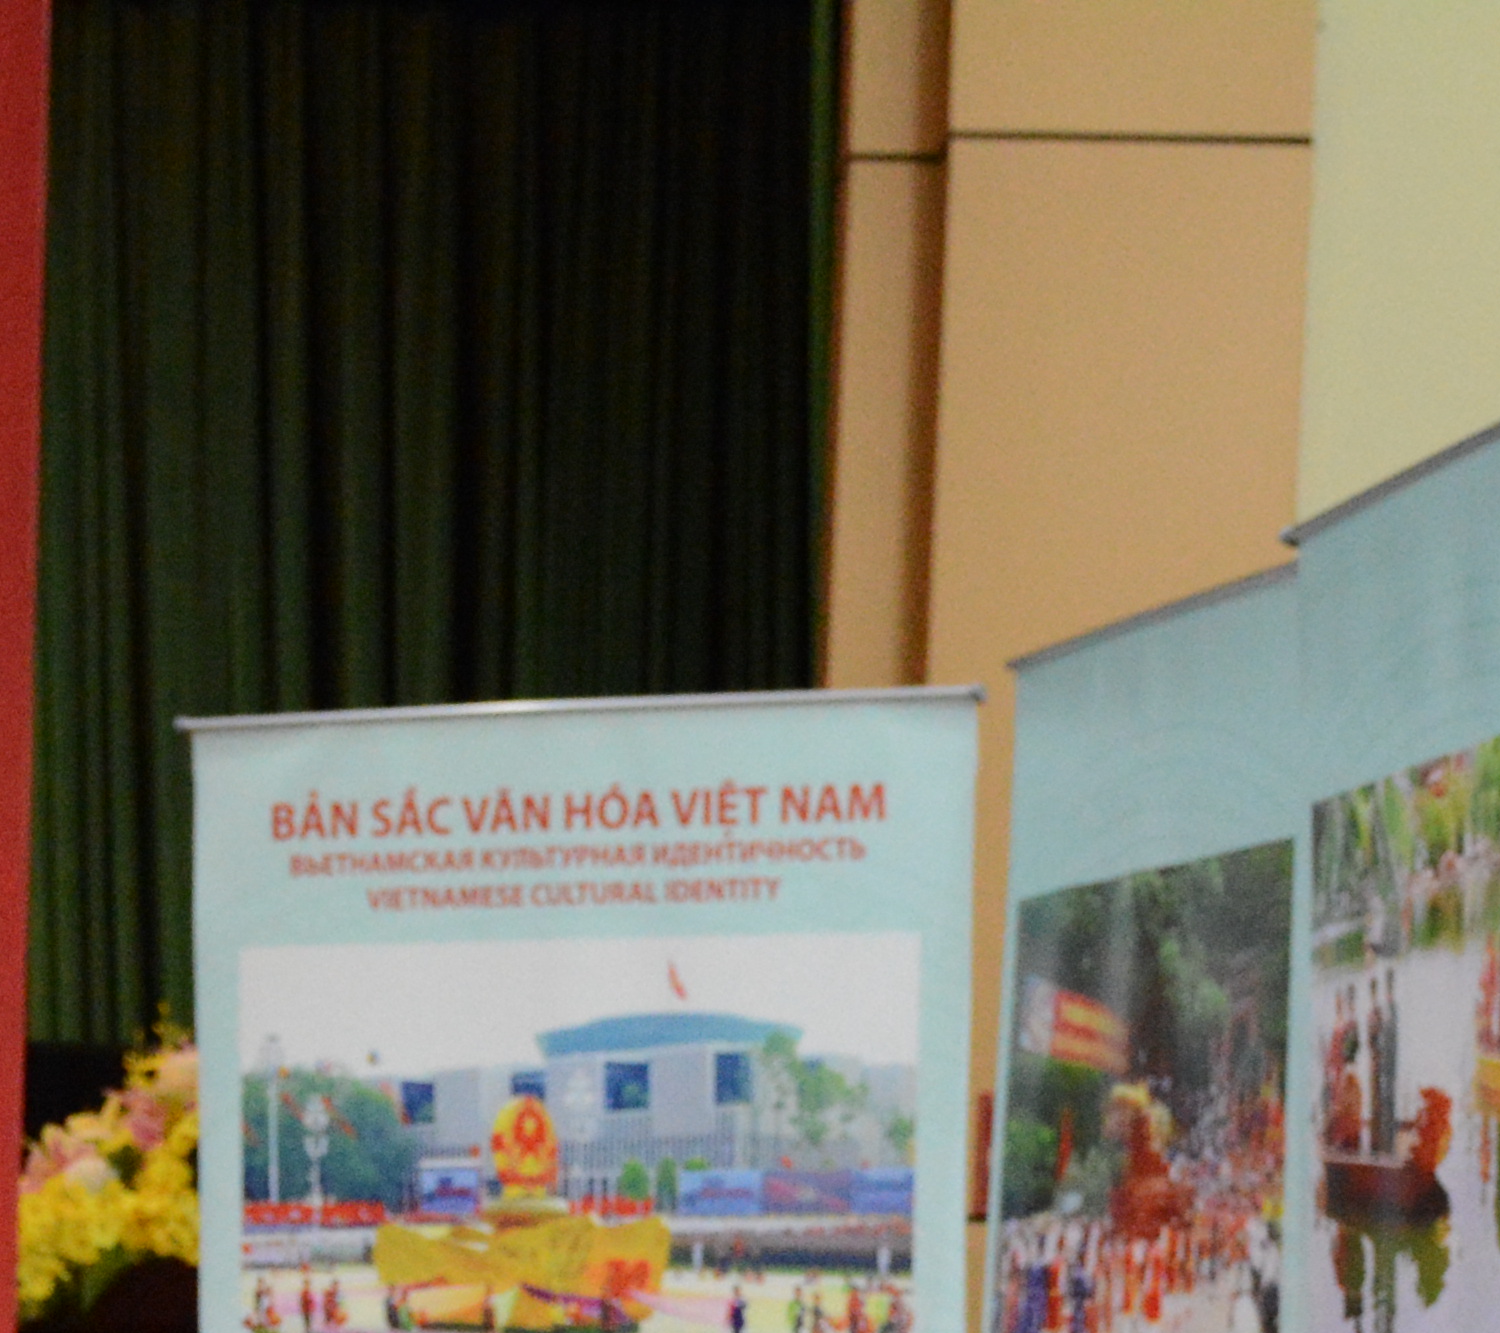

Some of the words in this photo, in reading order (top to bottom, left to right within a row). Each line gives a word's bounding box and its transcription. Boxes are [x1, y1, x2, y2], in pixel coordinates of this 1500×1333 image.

[270, 787, 358, 841] BẢN
[370, 784, 456, 838] SẮC
[465, 786, 555, 836] VĂN
[566, 780, 660, 831] HÓA
[669, 783, 765, 840] VIỆT
[779, 782, 887, 825] NAM
[290, 844, 477, 878] ВЬЕТНАМСКАЯ
[480, 841, 646, 872] КУЛЬТУРНАЯ
[651, 835, 867, 867] ИДЕНТИЧНОСТЬ
[367, 883, 525, 912] VIETNAMESE
[531, 879, 660, 908] CULTURAL
[664, 874, 783, 905] IDENTITY
